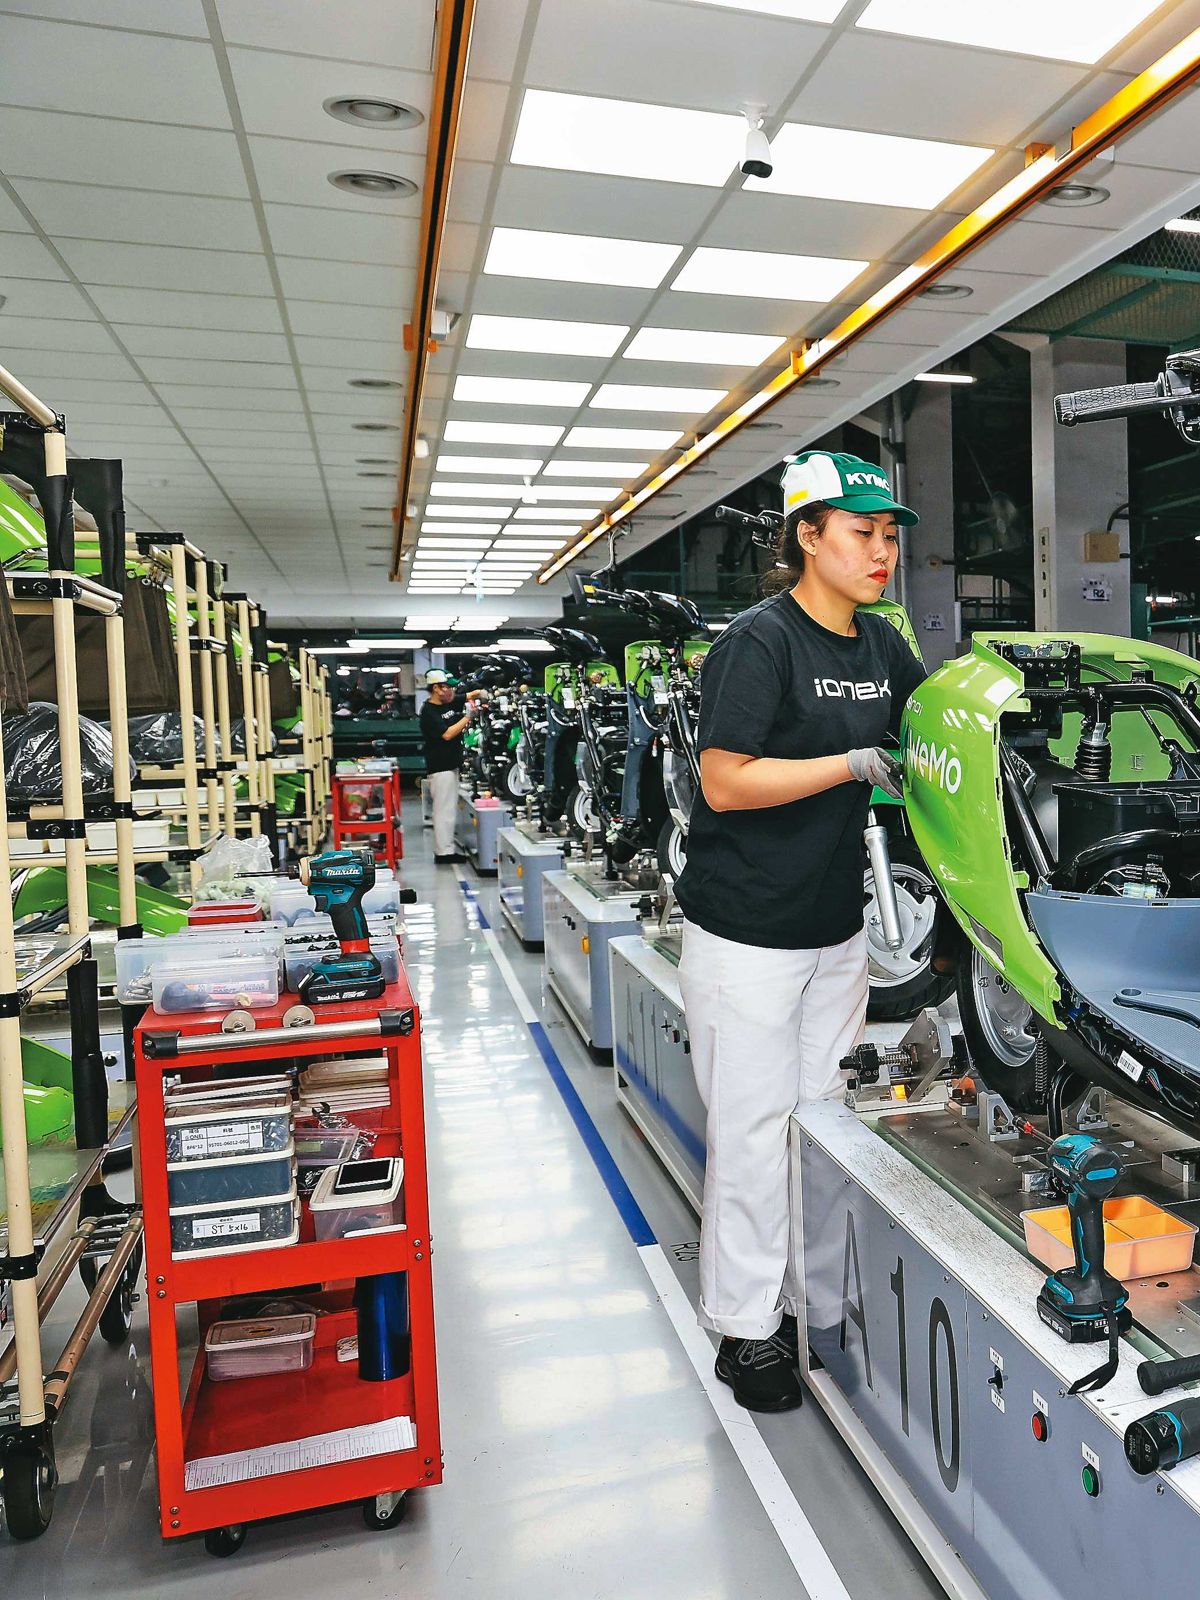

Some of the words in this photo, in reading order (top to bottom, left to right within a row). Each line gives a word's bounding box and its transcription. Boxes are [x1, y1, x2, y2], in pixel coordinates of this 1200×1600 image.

[1093, 588, 1105, 598] R2
[211, 1224, 224, 1235] ST
[840, 1209, 960, 1493] A10
